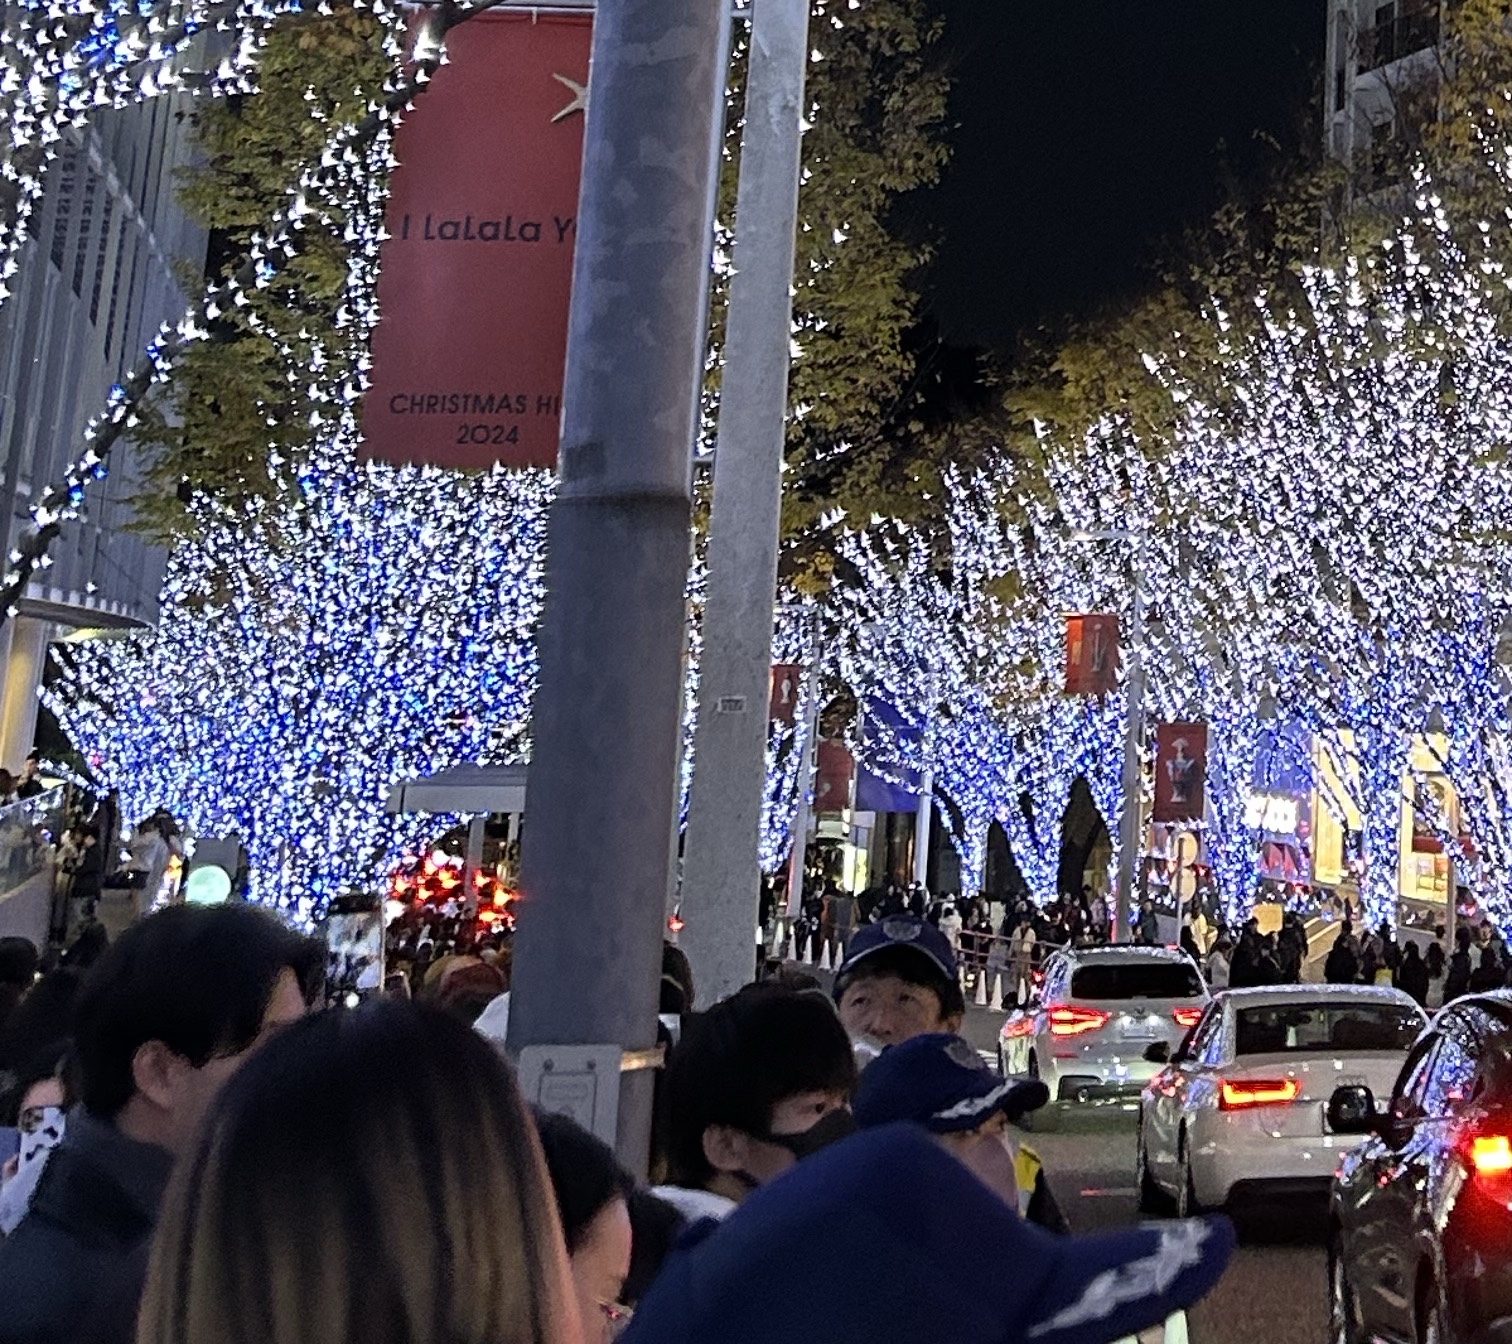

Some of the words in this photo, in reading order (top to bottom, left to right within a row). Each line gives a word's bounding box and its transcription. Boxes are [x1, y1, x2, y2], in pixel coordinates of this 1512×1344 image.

[402, 214, 410, 240] I
[424, 214, 542, 242] LaLaLa
[554, 216, 577, 243] Y
[389, 393, 527, 415] CHRISTMAS
[456, 423, 520, 445] 2024
